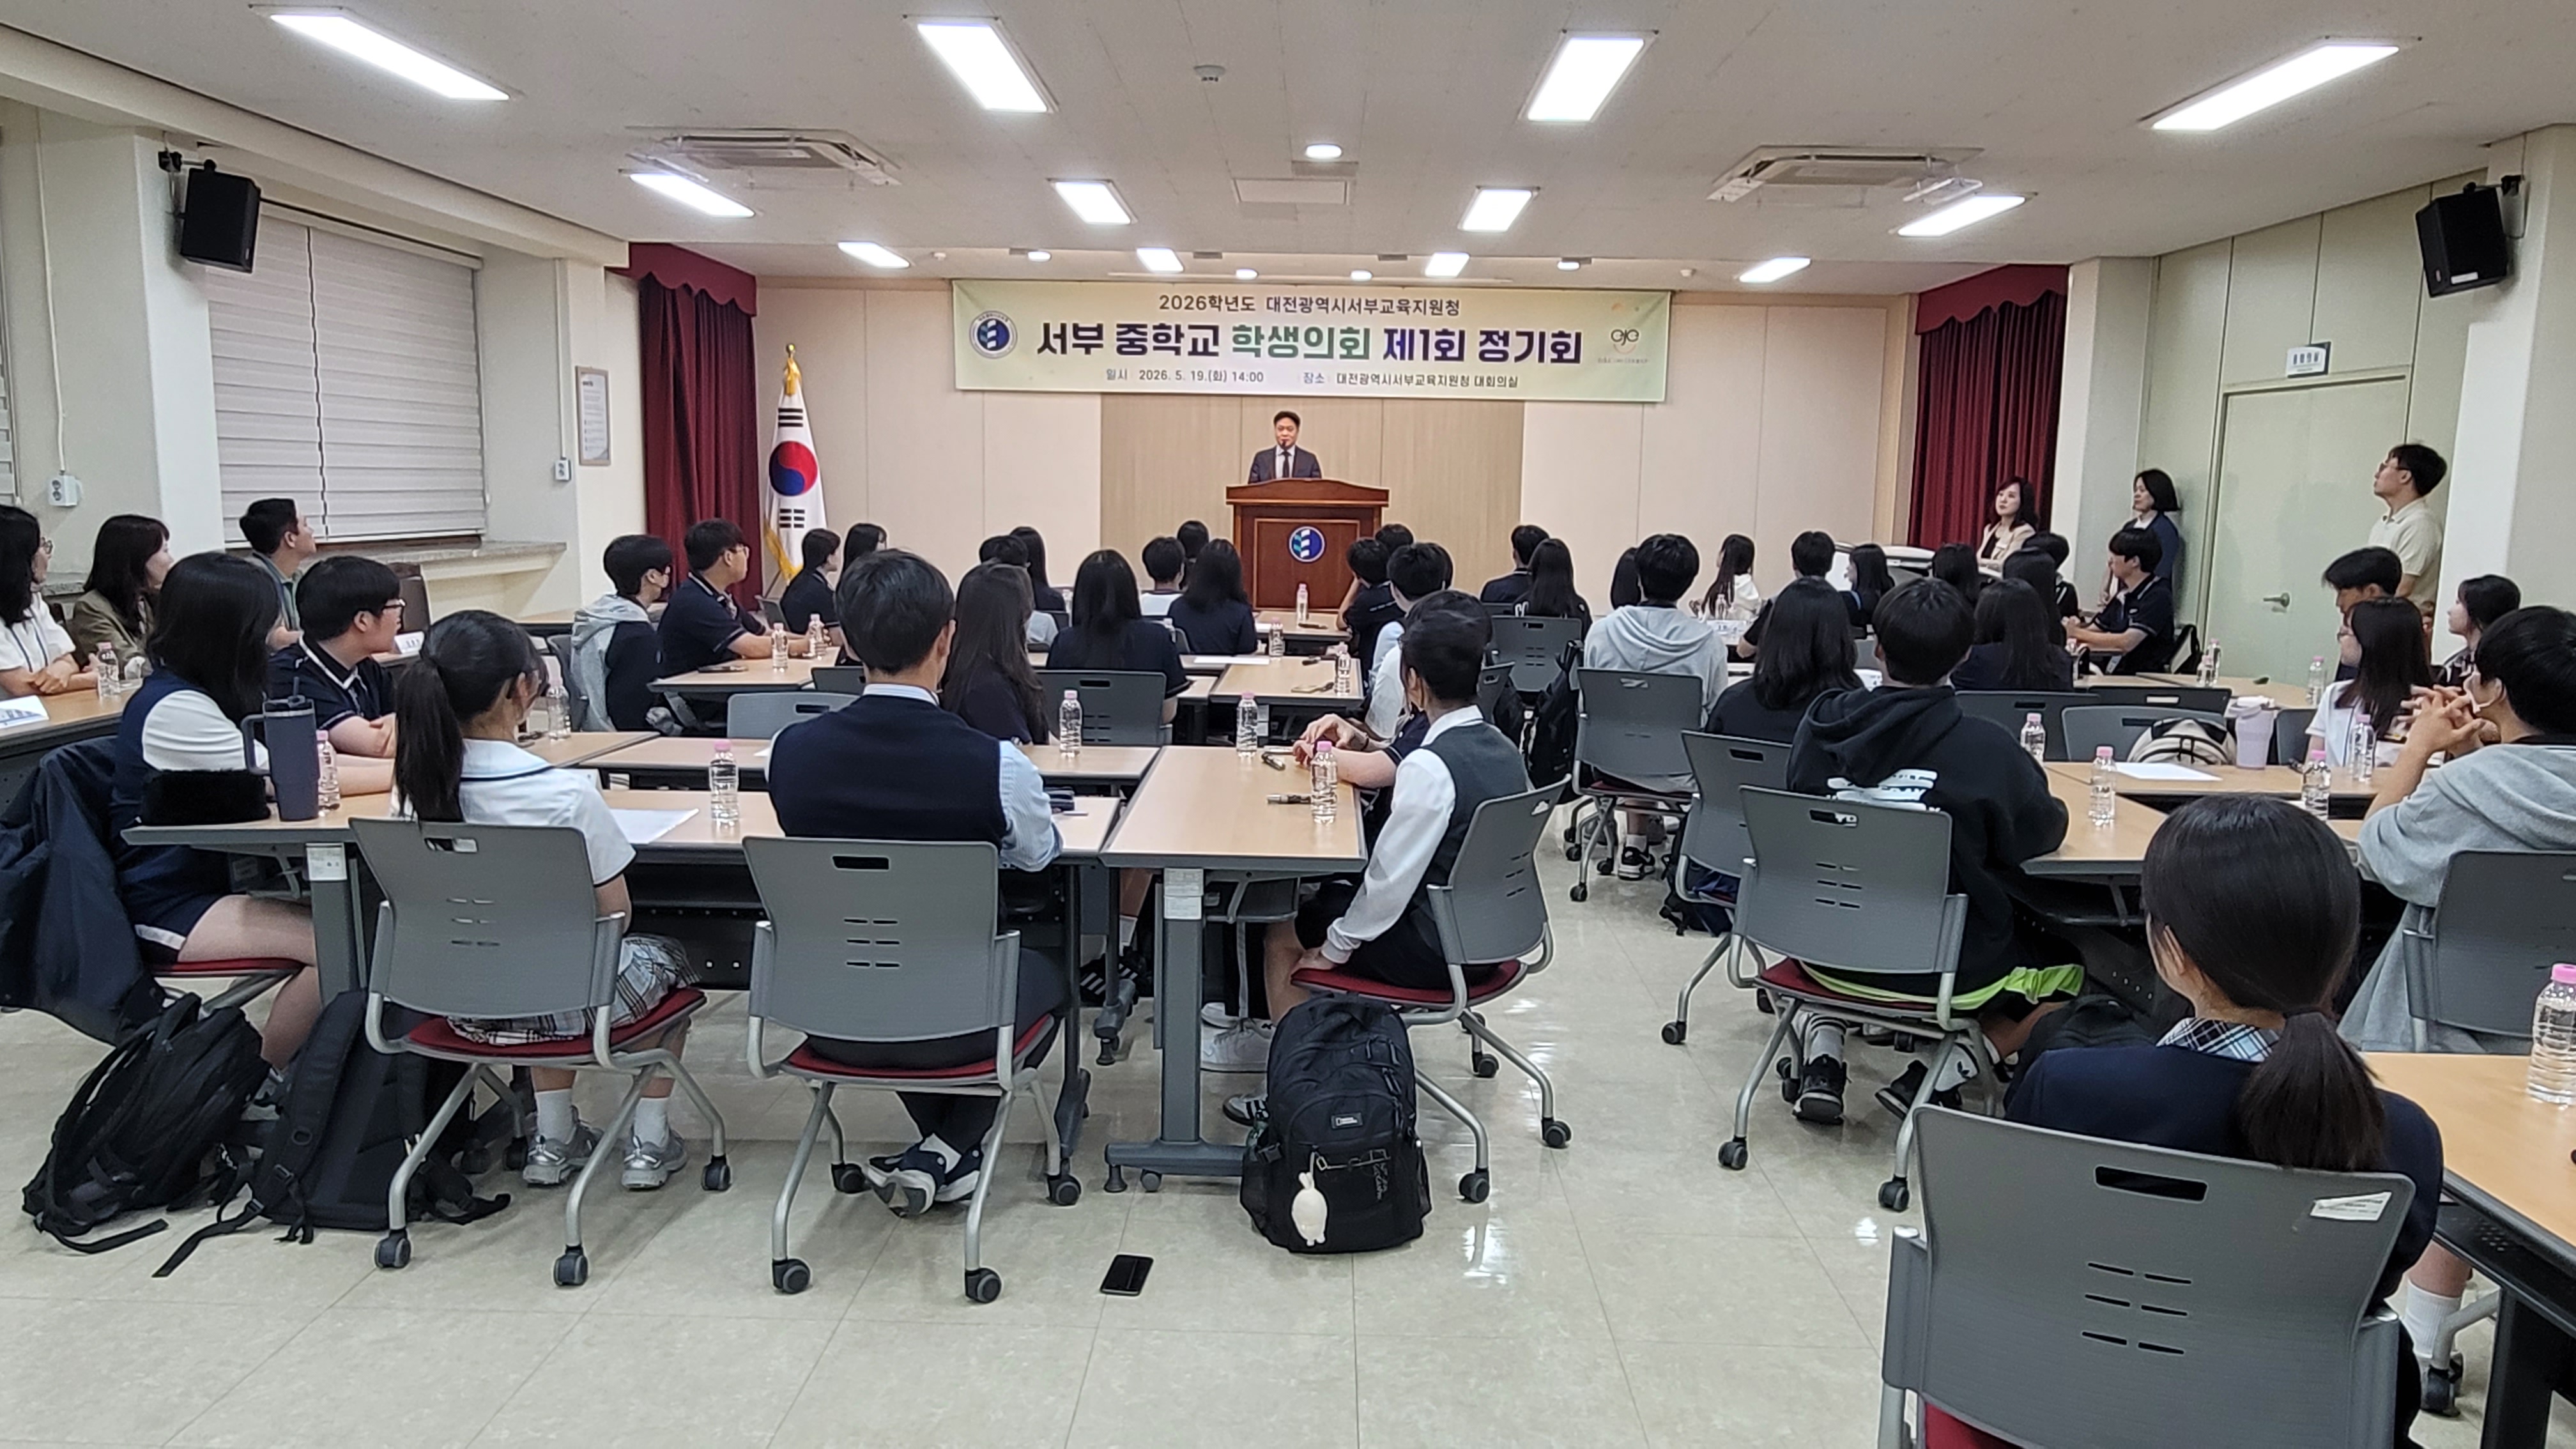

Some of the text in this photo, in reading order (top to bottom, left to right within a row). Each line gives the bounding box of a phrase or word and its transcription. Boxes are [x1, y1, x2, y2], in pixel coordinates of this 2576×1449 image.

[1159, 295, 1460, 316] 2026학년도 대전광역시서부교육지원청
[1036, 323, 1582, 364] 서부 중학교 학생의회 제1회 정기회
[1139, 369, 1170, 381] 2026.
[1232, 371, 1264, 383] 14:00
[1337, 372, 1470, 387] 대전광역시서부교육지원청
[1474, 375, 1519, 388] 대회의실
